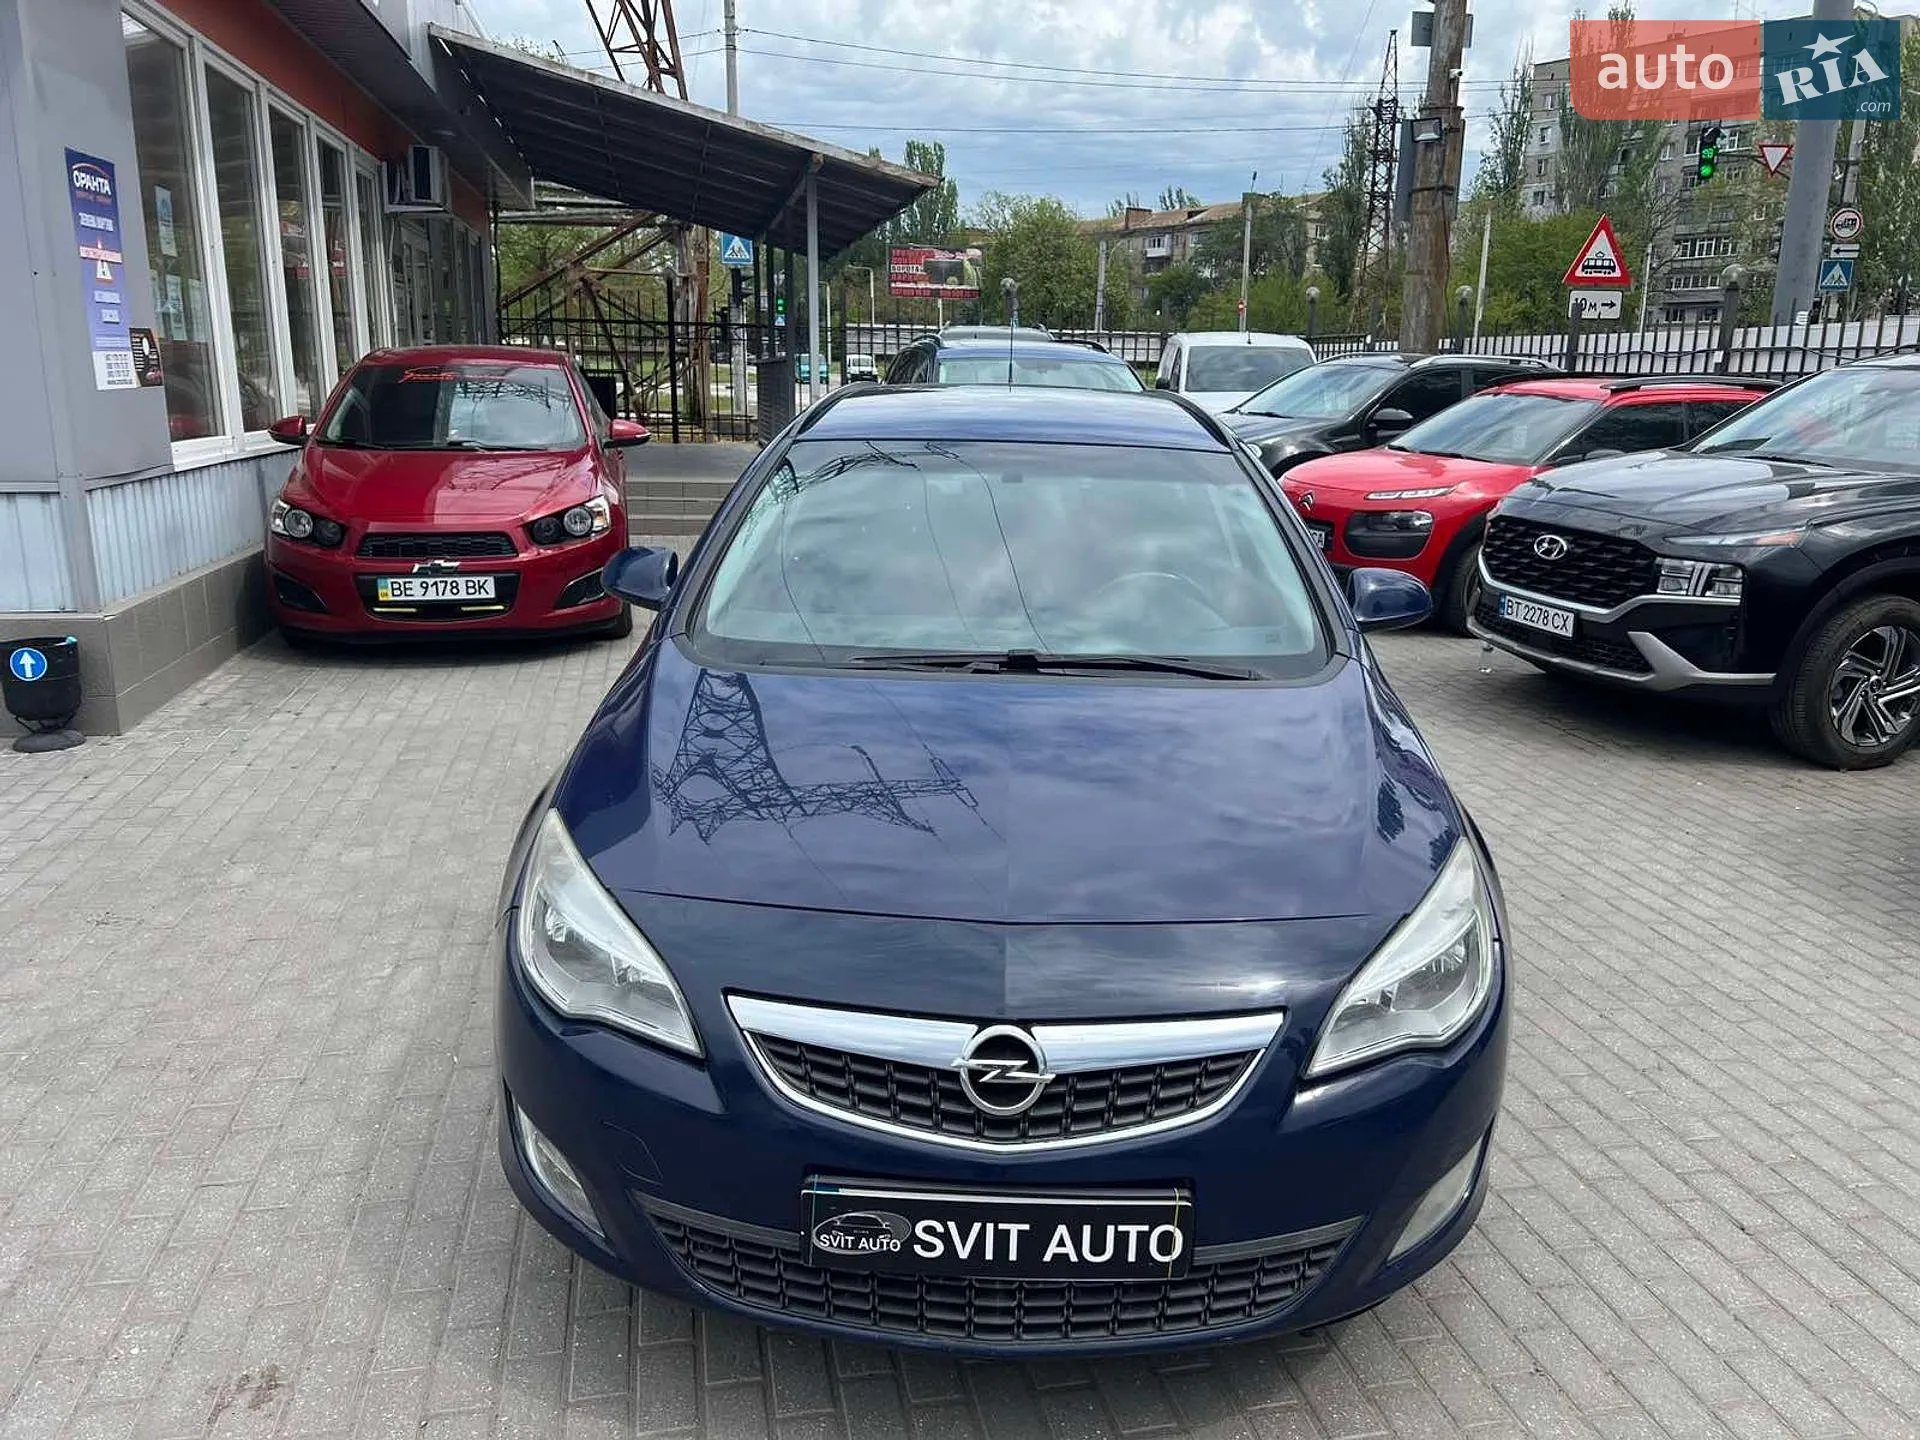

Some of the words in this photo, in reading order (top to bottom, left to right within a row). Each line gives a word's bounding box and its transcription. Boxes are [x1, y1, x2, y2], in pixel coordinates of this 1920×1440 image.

[73, 170, 112, 195] ОРАНТА
[390, 581, 414, 597] BE
[420, 580, 460, 597] 9178
[465, 579, 490, 596] BK
[1507, 599, 1522, 617] BT
[1523, 604, 1549, 627] 2278
[1551, 612, 1570, 632] CX
[819, 1233, 856, 1249] SVIT
[858, 1236, 902, 1252] AUTO
[913, 1219, 1030, 1261] SVIT
[1043, 1222, 1184, 1264] AUTO
